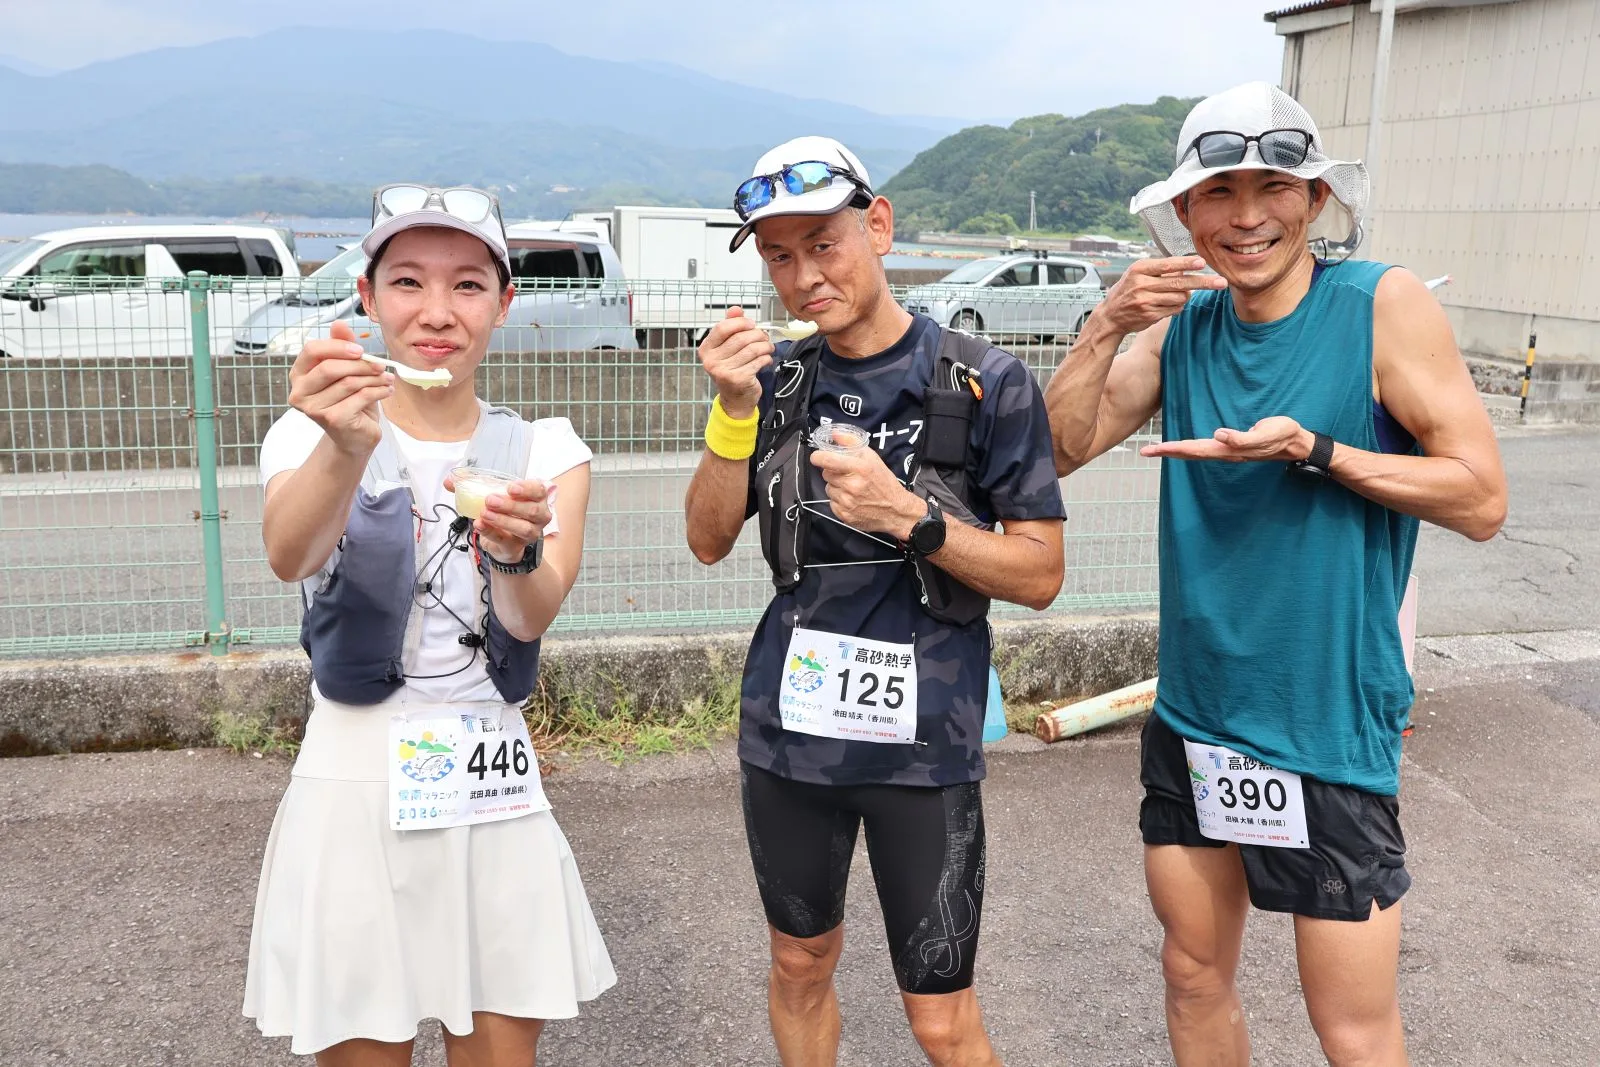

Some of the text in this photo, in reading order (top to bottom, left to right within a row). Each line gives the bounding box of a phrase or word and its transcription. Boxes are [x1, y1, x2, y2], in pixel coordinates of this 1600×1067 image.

[844, 398, 857, 413] ig
[855, 647, 913, 669] 高砂熱学
[837, 668, 905, 710] 125
[467, 738, 529, 780] 446
[1217, 776, 1287, 812] 390
